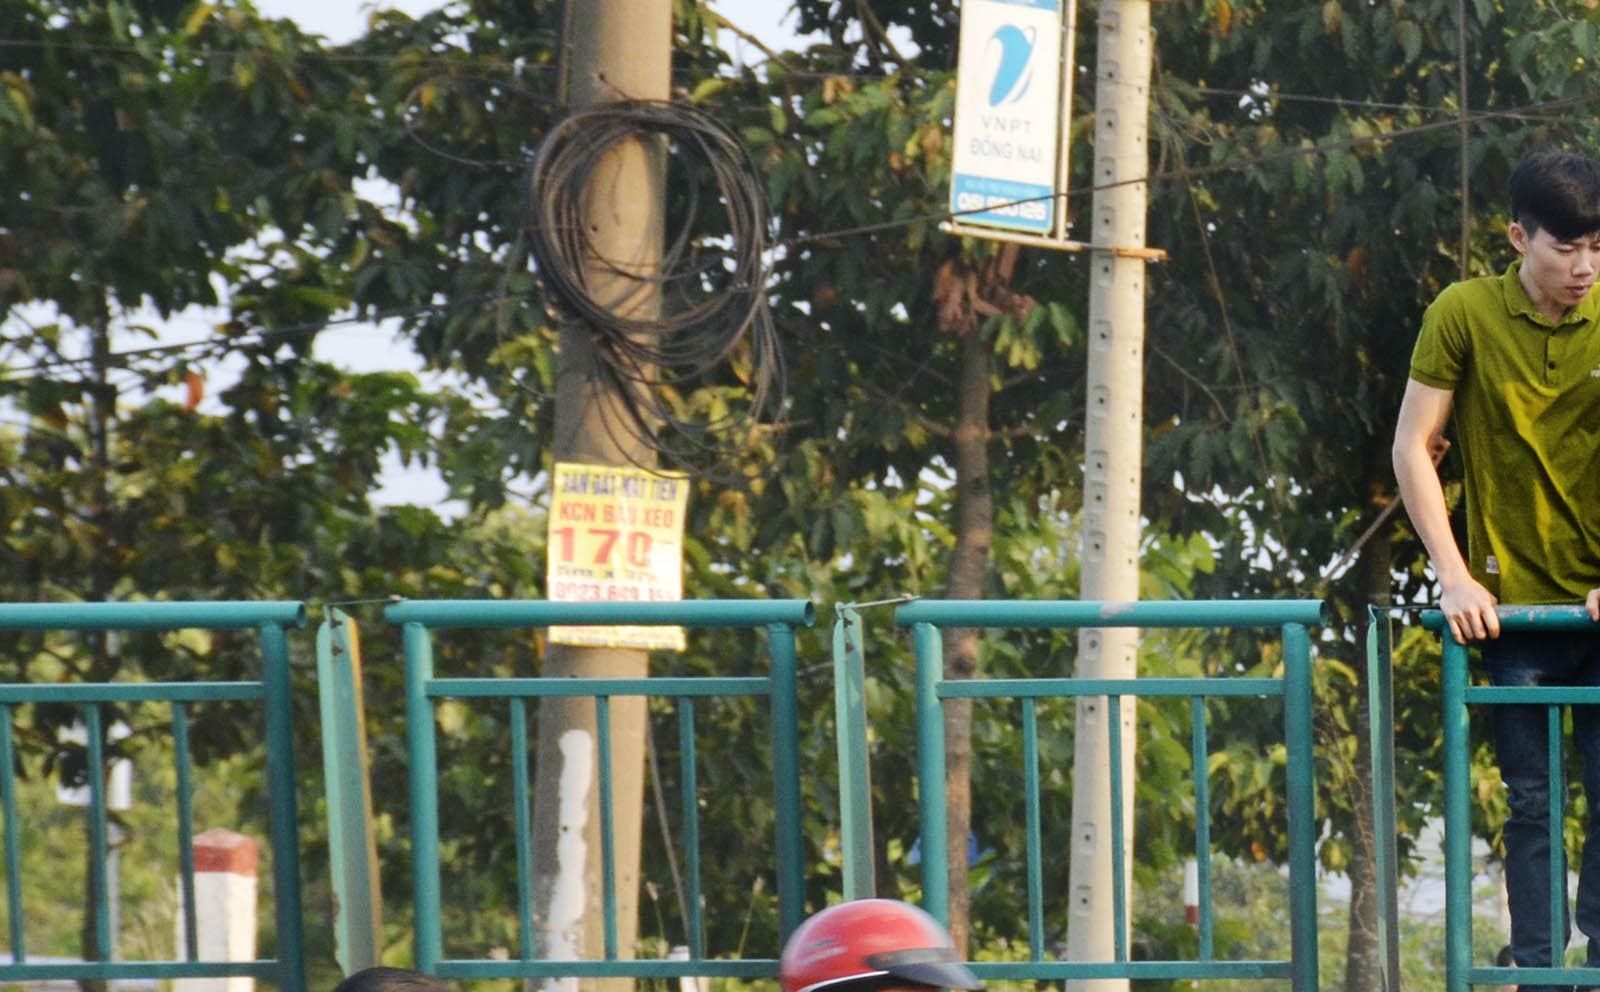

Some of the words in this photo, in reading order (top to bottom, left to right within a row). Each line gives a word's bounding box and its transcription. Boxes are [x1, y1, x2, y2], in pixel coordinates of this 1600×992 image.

[981, 115, 1032, 133] VNPT
[1017, 146, 1042, 162] NAI
[560, 503, 596, 522] KCN
[552, 526, 654, 567] 170
